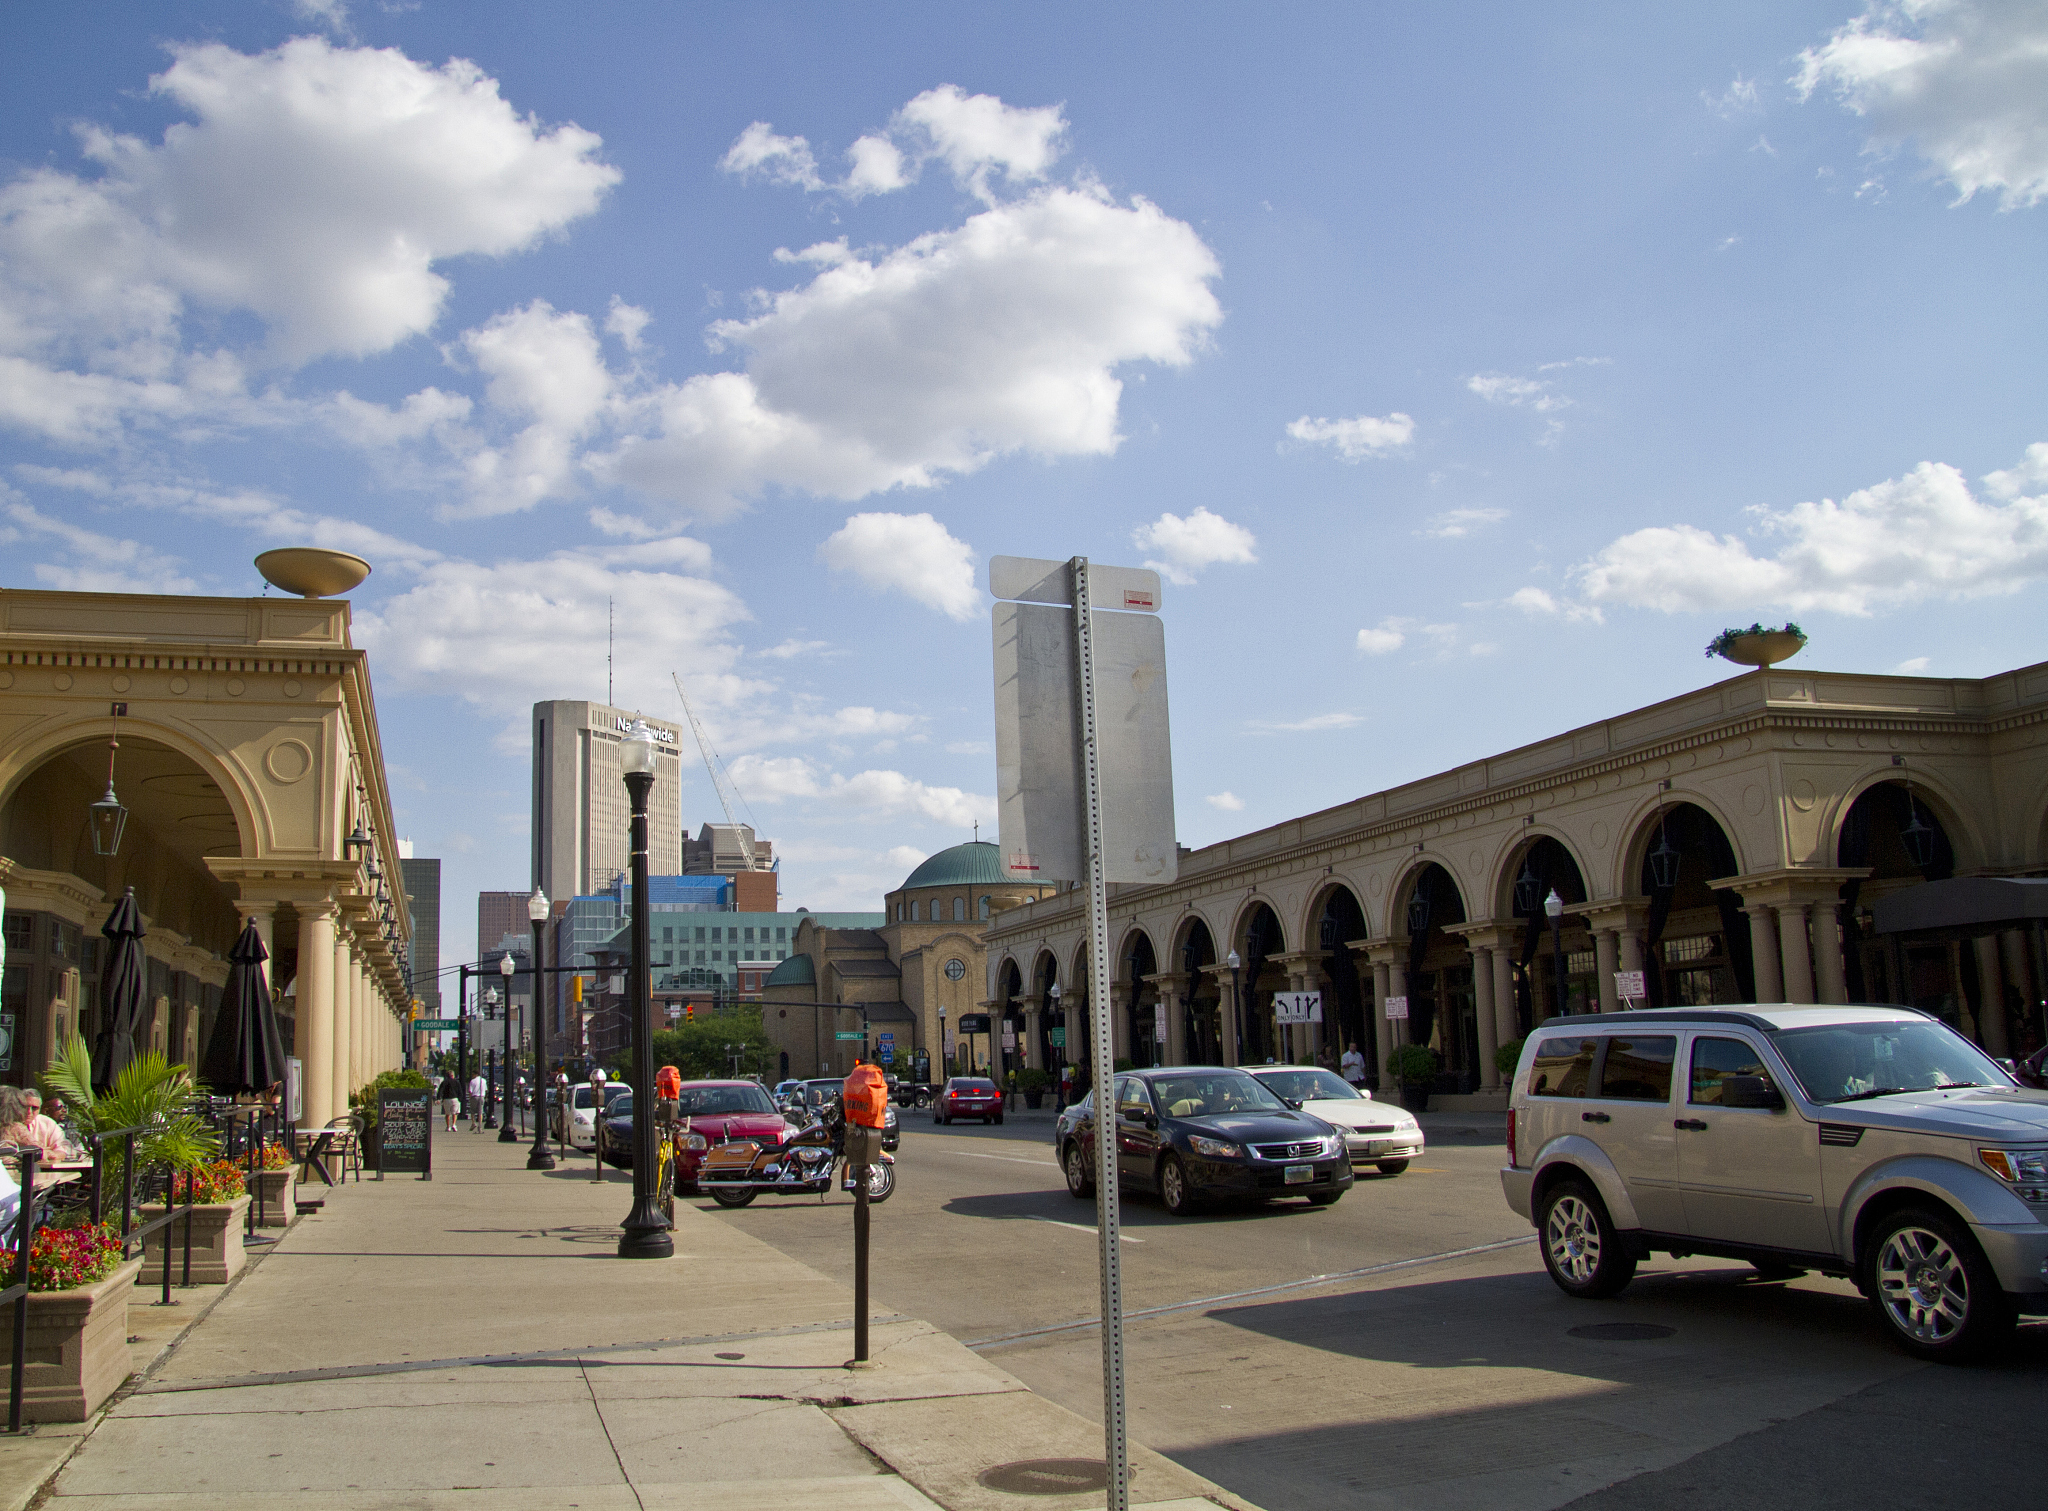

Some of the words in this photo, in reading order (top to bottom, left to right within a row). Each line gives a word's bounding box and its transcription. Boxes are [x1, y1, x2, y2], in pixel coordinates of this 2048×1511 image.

[617, 716, 674, 743] Nawide
[881, 1043, 893, 1052] 670
[384, 1101, 427, 1109] LOUNGE
